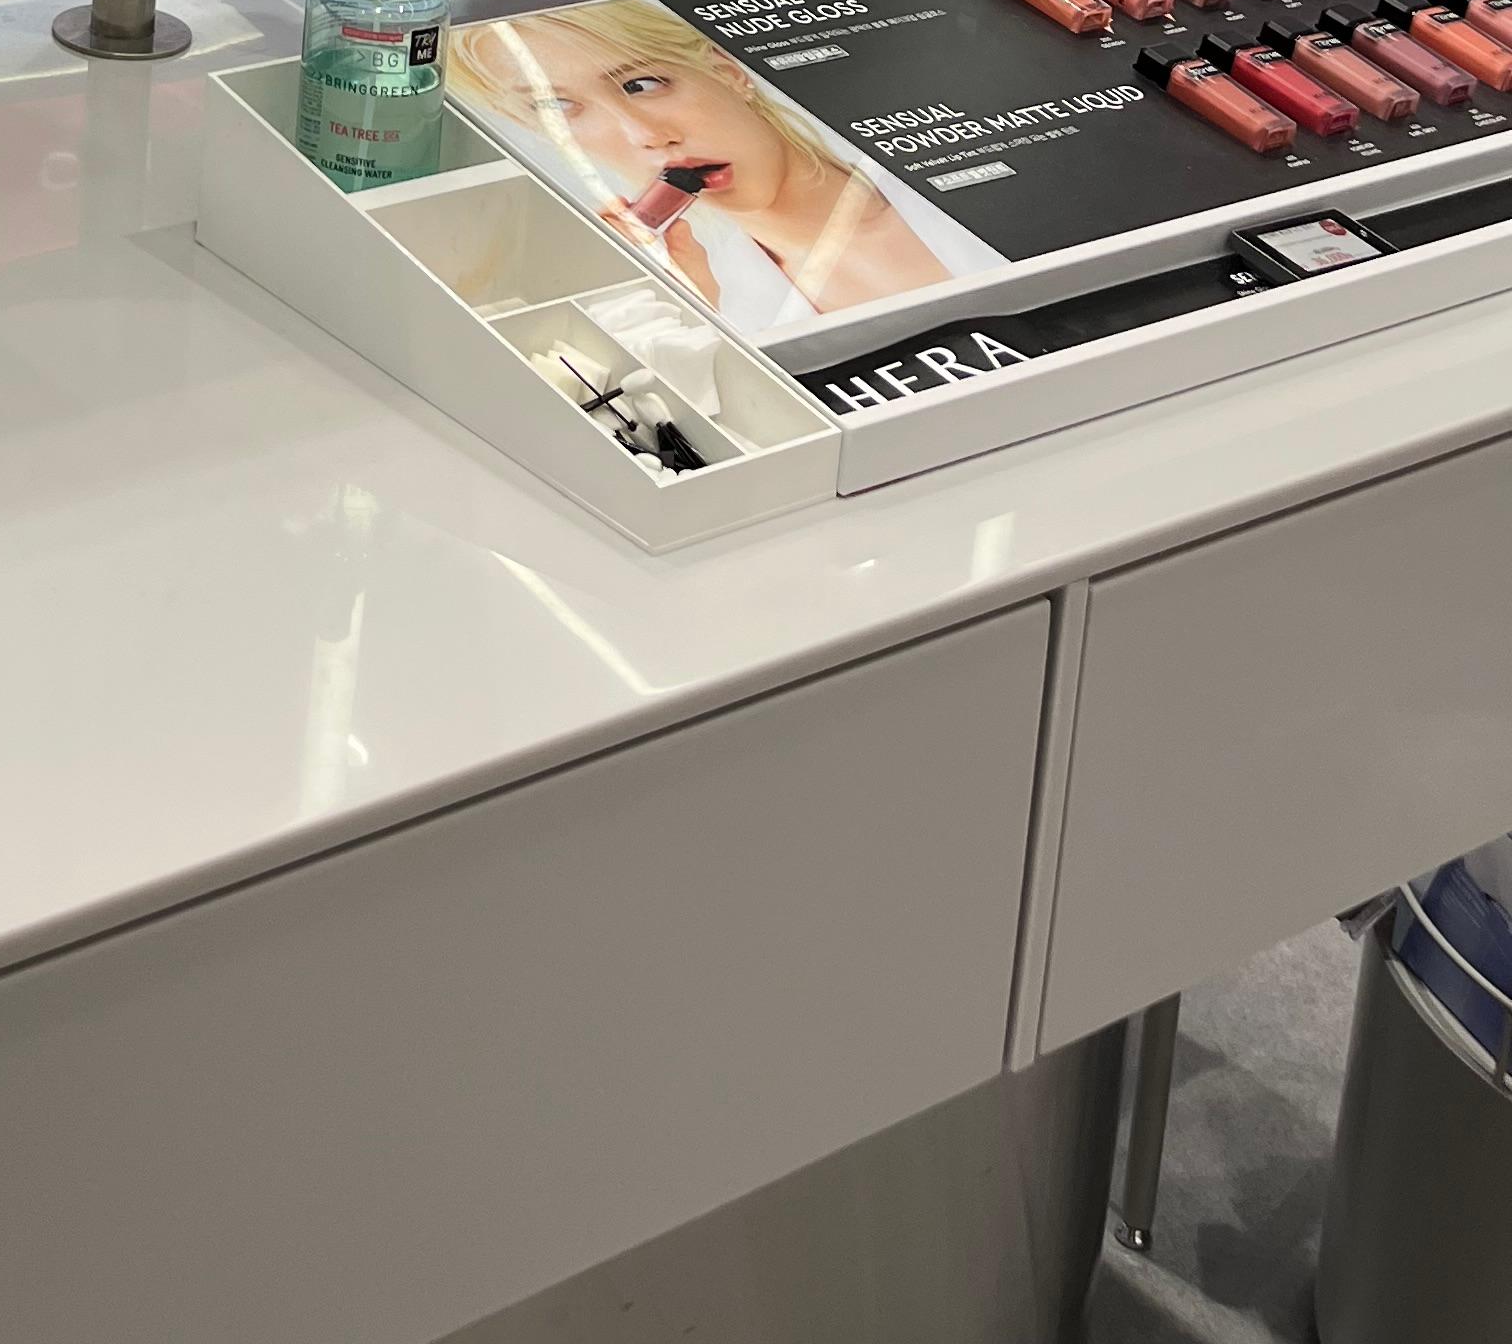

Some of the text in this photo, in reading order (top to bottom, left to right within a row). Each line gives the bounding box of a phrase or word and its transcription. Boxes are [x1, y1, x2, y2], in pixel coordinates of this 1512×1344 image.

[715, 14, 791, 39] NUDE
[414, 31, 437, 49] TRY
[416, 48, 433, 61] ME
[850, 102, 966, 139] SENSUAL
[875, 119, 993, 158] POWDER
[983, 100, 1071, 132] MATTE
[1061, 84, 1145, 114] LIQUID
[329, 121, 349, 138] TEA
[352, 127, 380, 142] TREE
[321, 159, 393, 179] CLEANSING WATER
[336, 153, 376, 168] SENSITIVE
